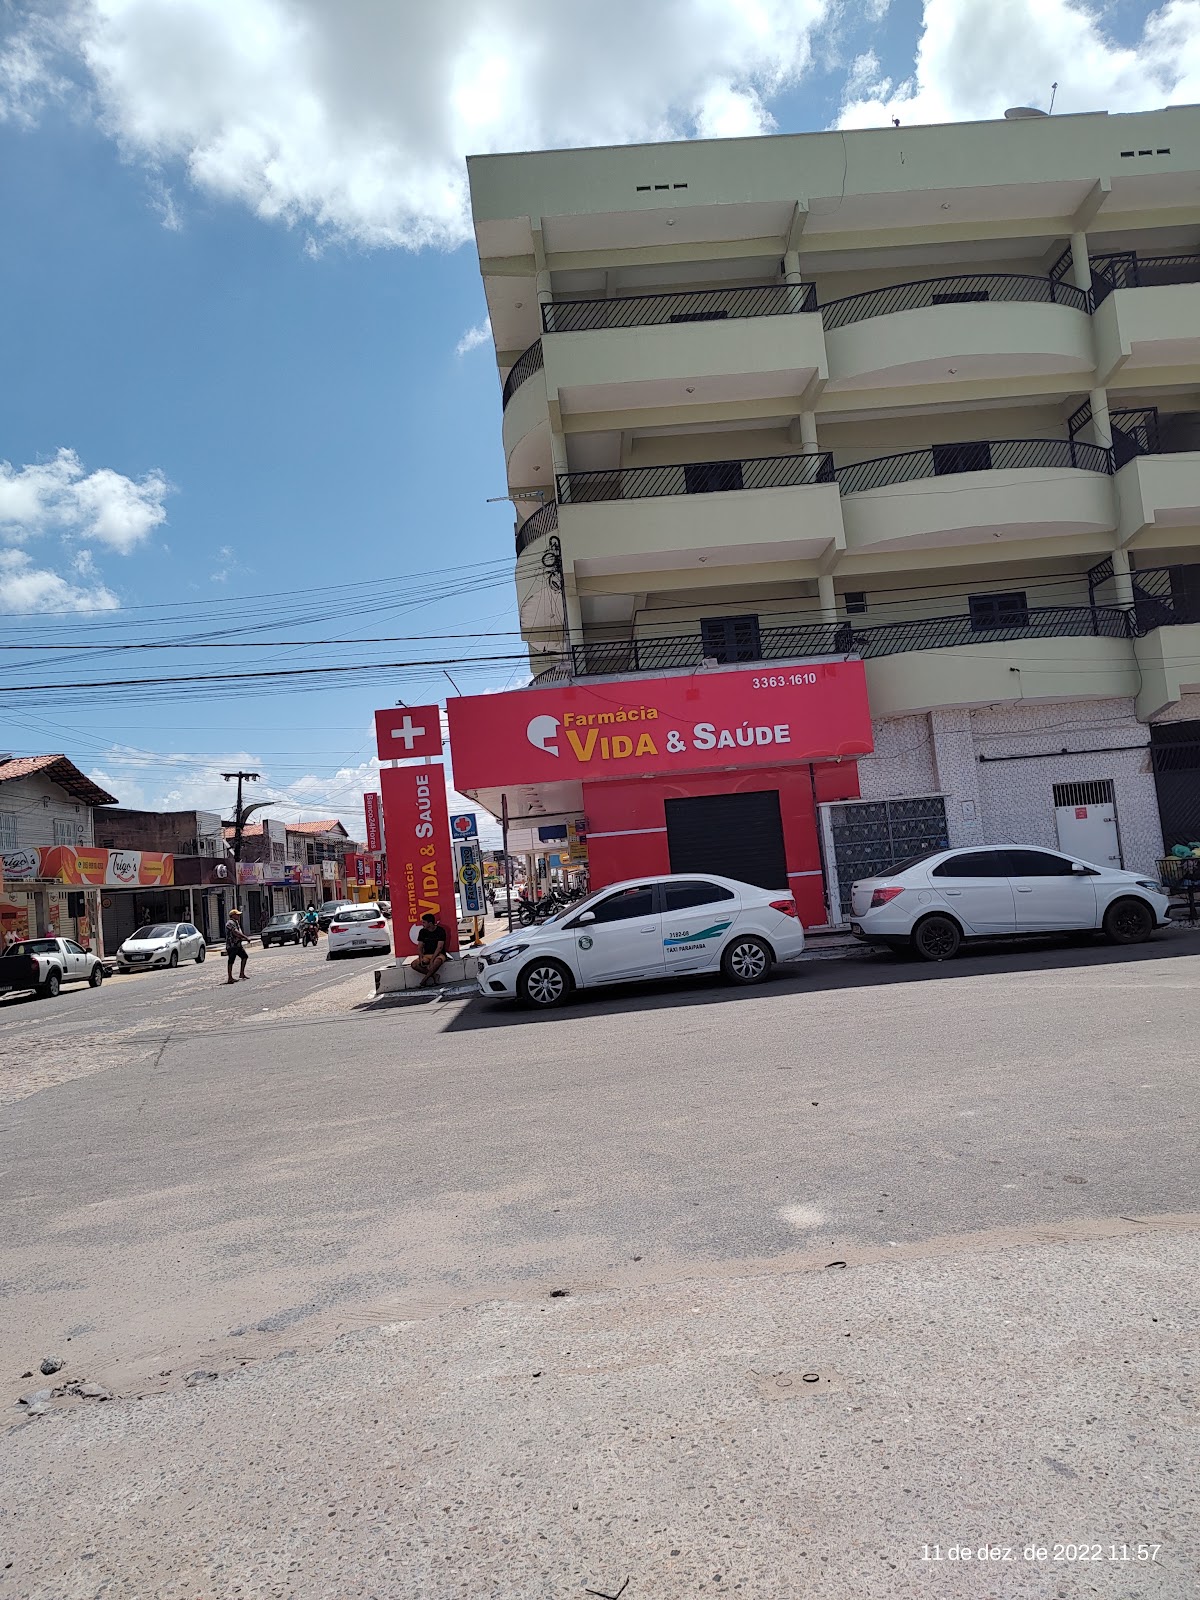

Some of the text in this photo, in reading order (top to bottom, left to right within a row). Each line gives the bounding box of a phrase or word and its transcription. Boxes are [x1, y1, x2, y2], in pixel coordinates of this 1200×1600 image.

[752, 672, 817, 690] 3363.1610
[563, 706, 659, 728] Farmácia
[565, 721, 791, 762] VIDA & SAÚDE
[367, 794, 376, 849] Banco24Horas
[415, 774, 434, 838] SAÚDE
[110, 852, 137, 876] Trigo's
[420, 844, 435, 856] &
[404, 863, 418, 923] Farmácia
